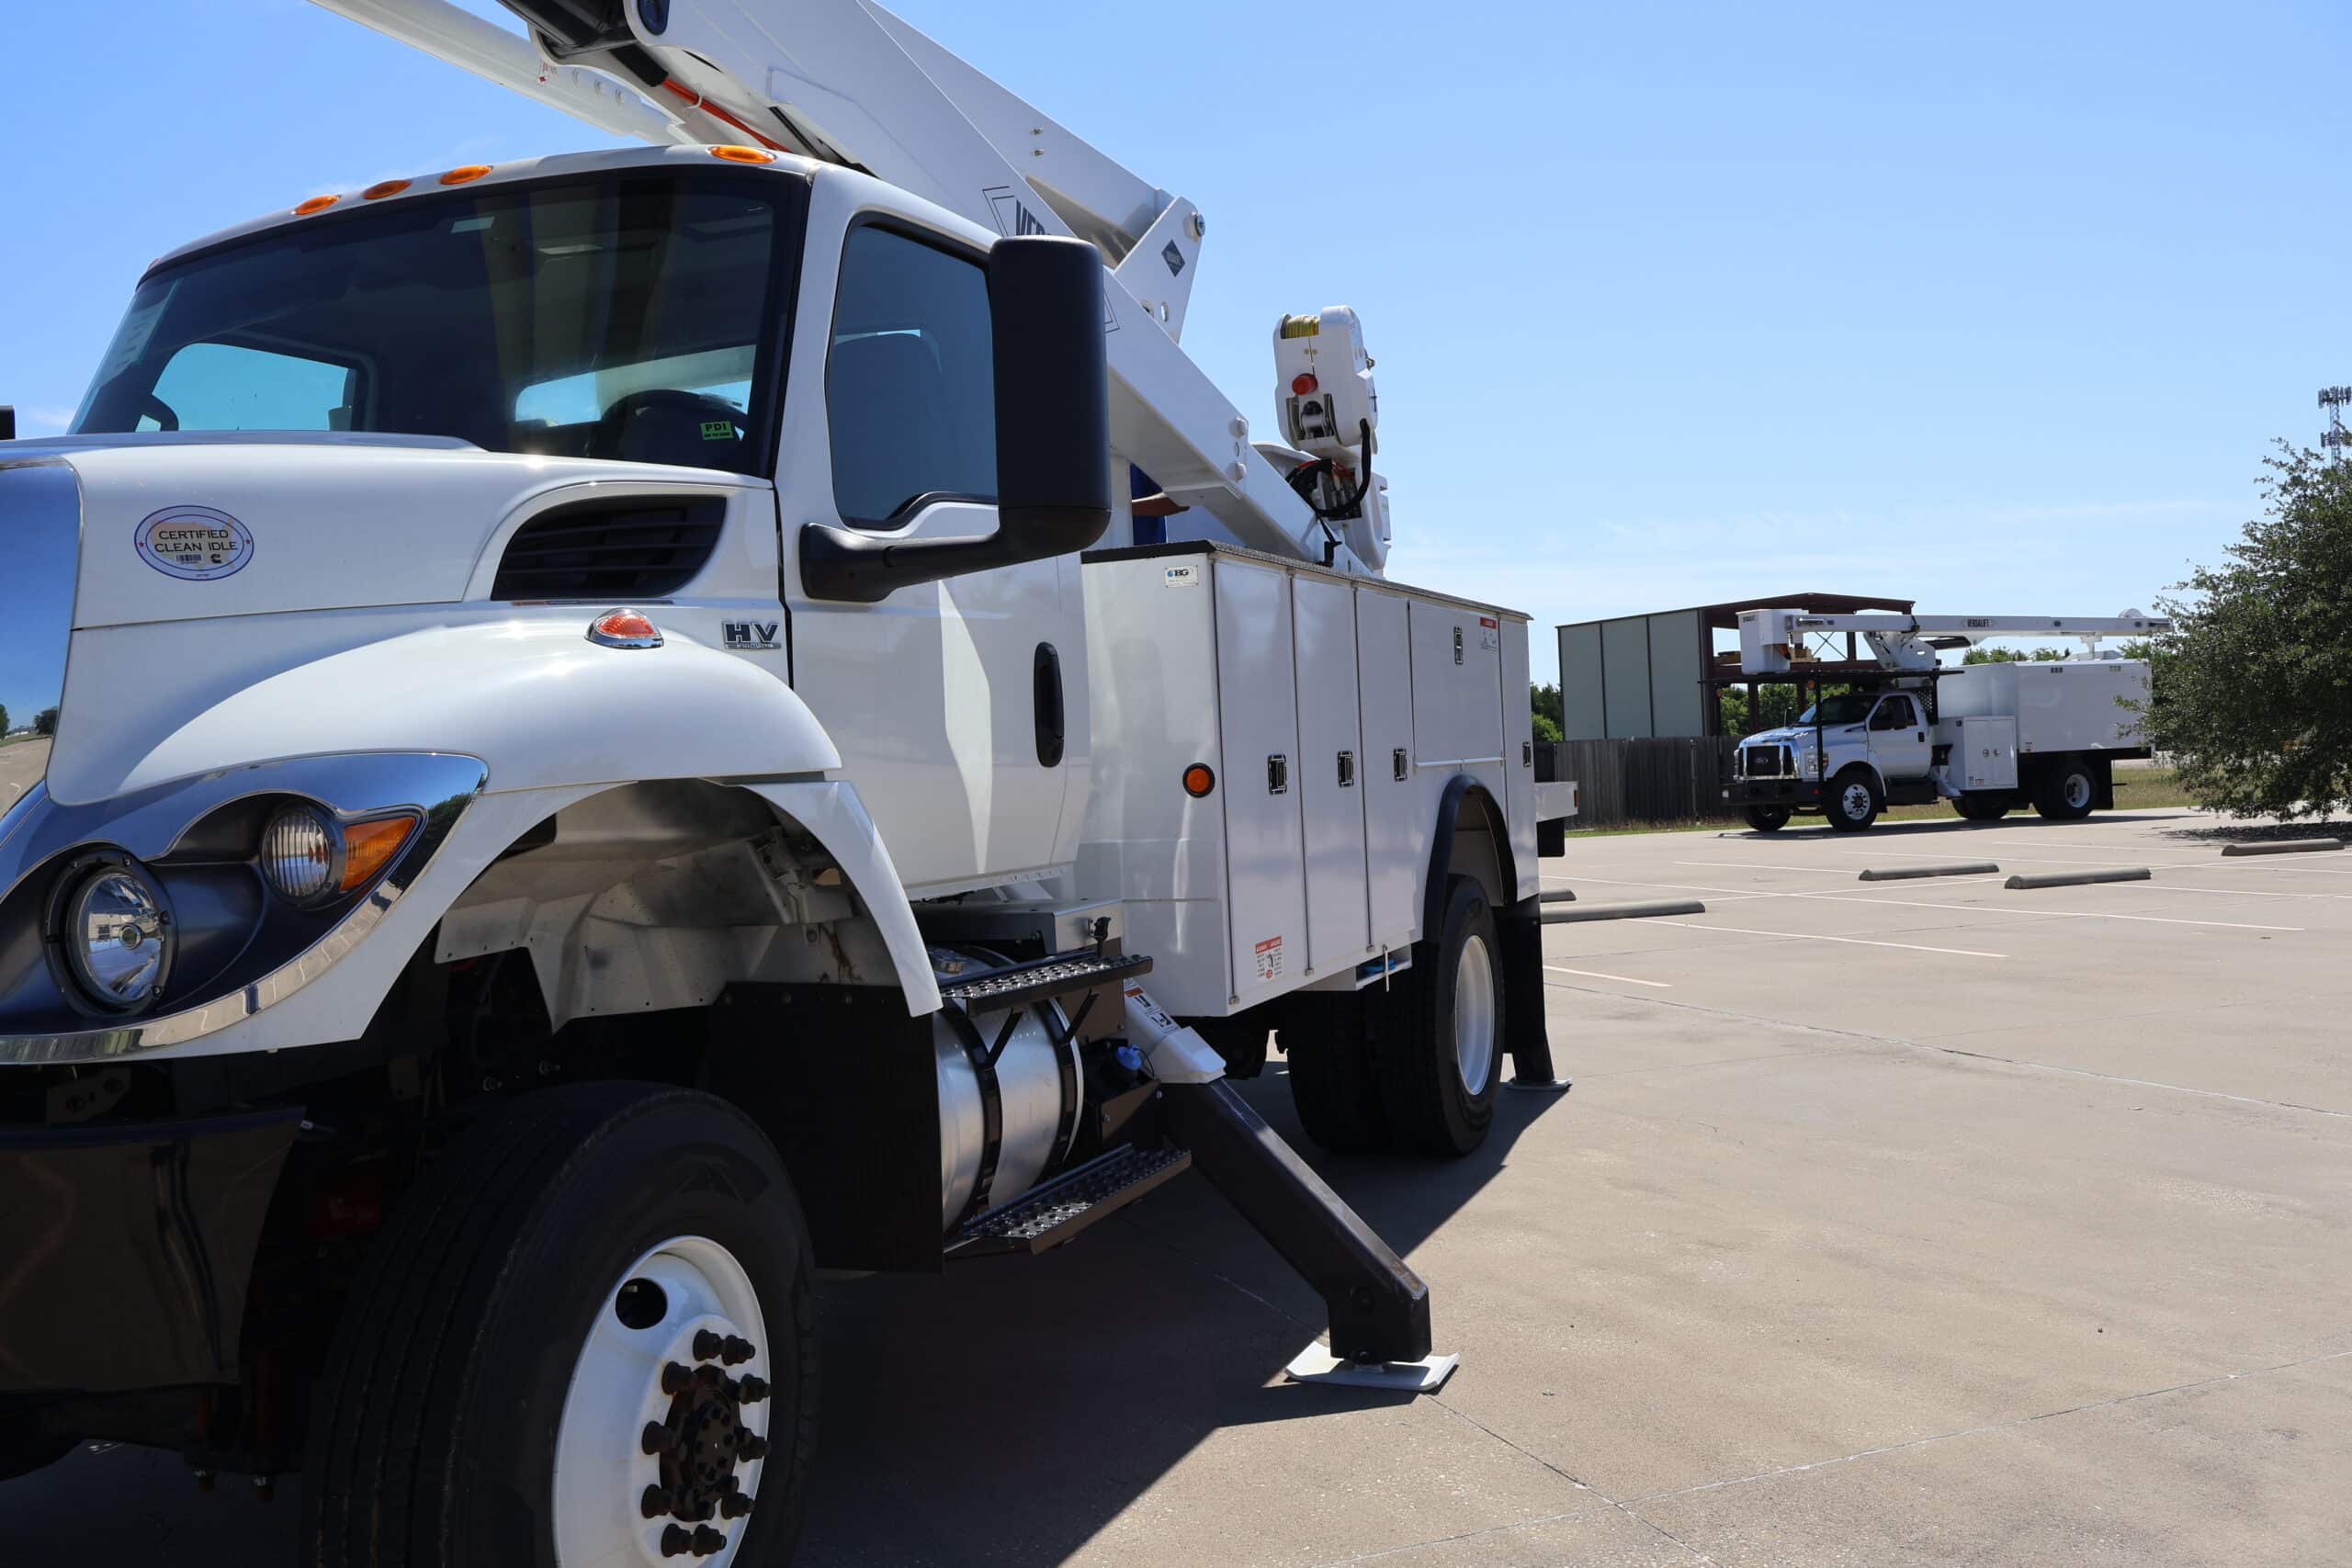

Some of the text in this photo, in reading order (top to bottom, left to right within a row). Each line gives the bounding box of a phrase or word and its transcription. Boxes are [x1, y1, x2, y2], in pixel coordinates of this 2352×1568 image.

[705, 423, 727, 432] PDI
[159, 529, 229, 540] CERTIFIED
[154, 541, 238, 553] CLEAN IDLE
[723, 624, 779, 643] HV
